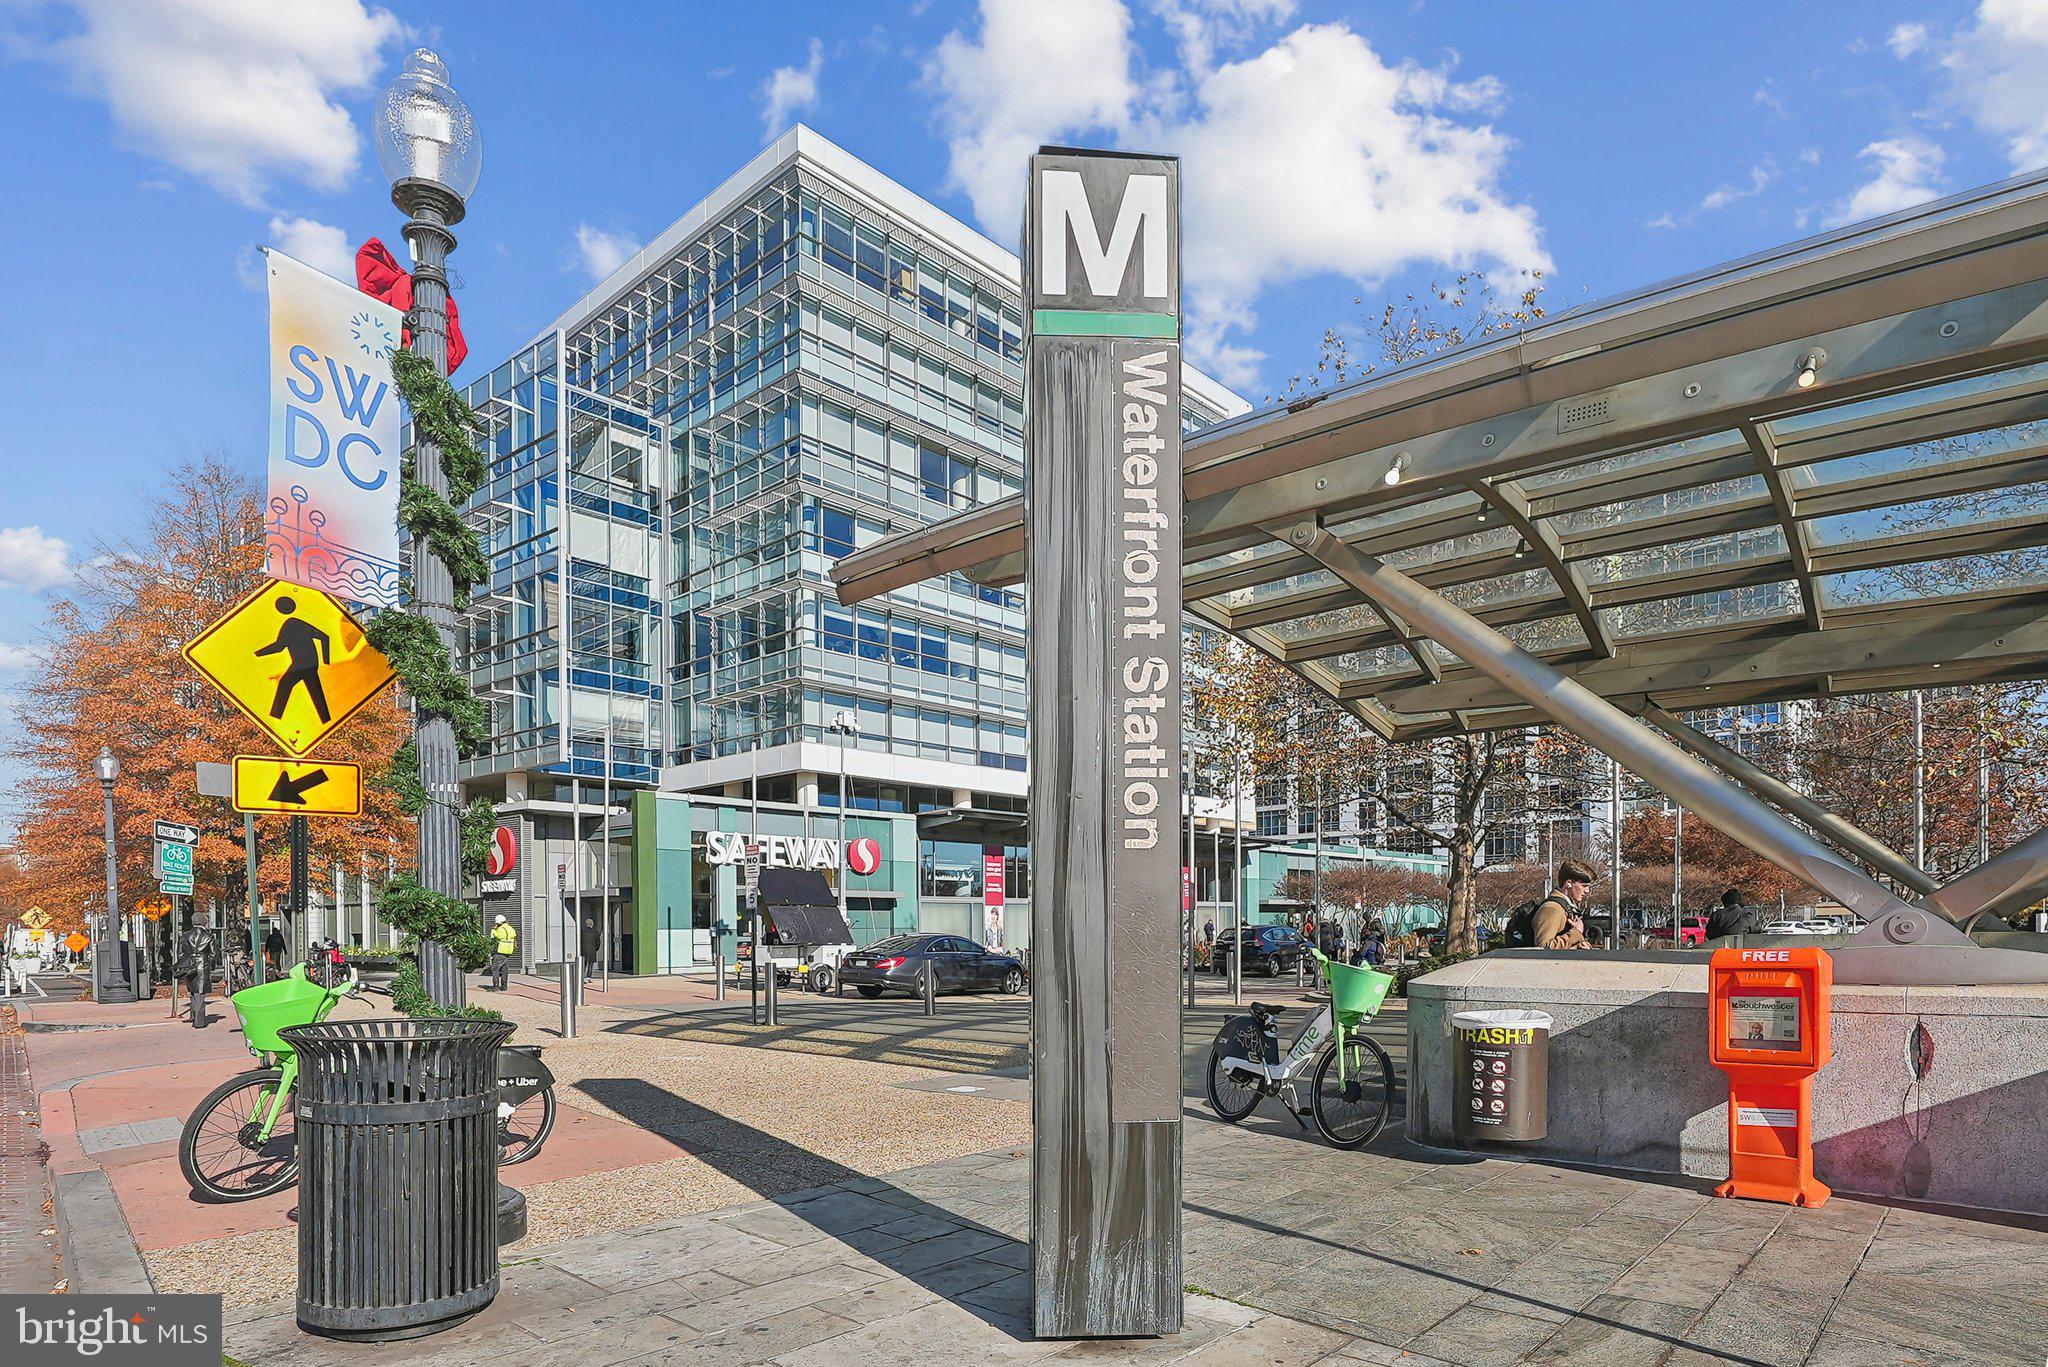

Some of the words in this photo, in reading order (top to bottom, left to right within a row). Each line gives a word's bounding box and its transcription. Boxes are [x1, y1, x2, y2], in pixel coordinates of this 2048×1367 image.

[1041, 169, 1168, 298] M
[286, 344, 388, 429] SW
[284, 403, 388, 491] DC
[1122, 350, 1170, 641] Waterfront
[1122, 654, 1170, 850] Station
[159, 826, 172, 837] ONE
[173, 829, 186, 839] WAY
[746, 856, 758, 865] NO
[1741, 950, 1791, 962] FREE
[515, 1076, 539, 1087] Uber
